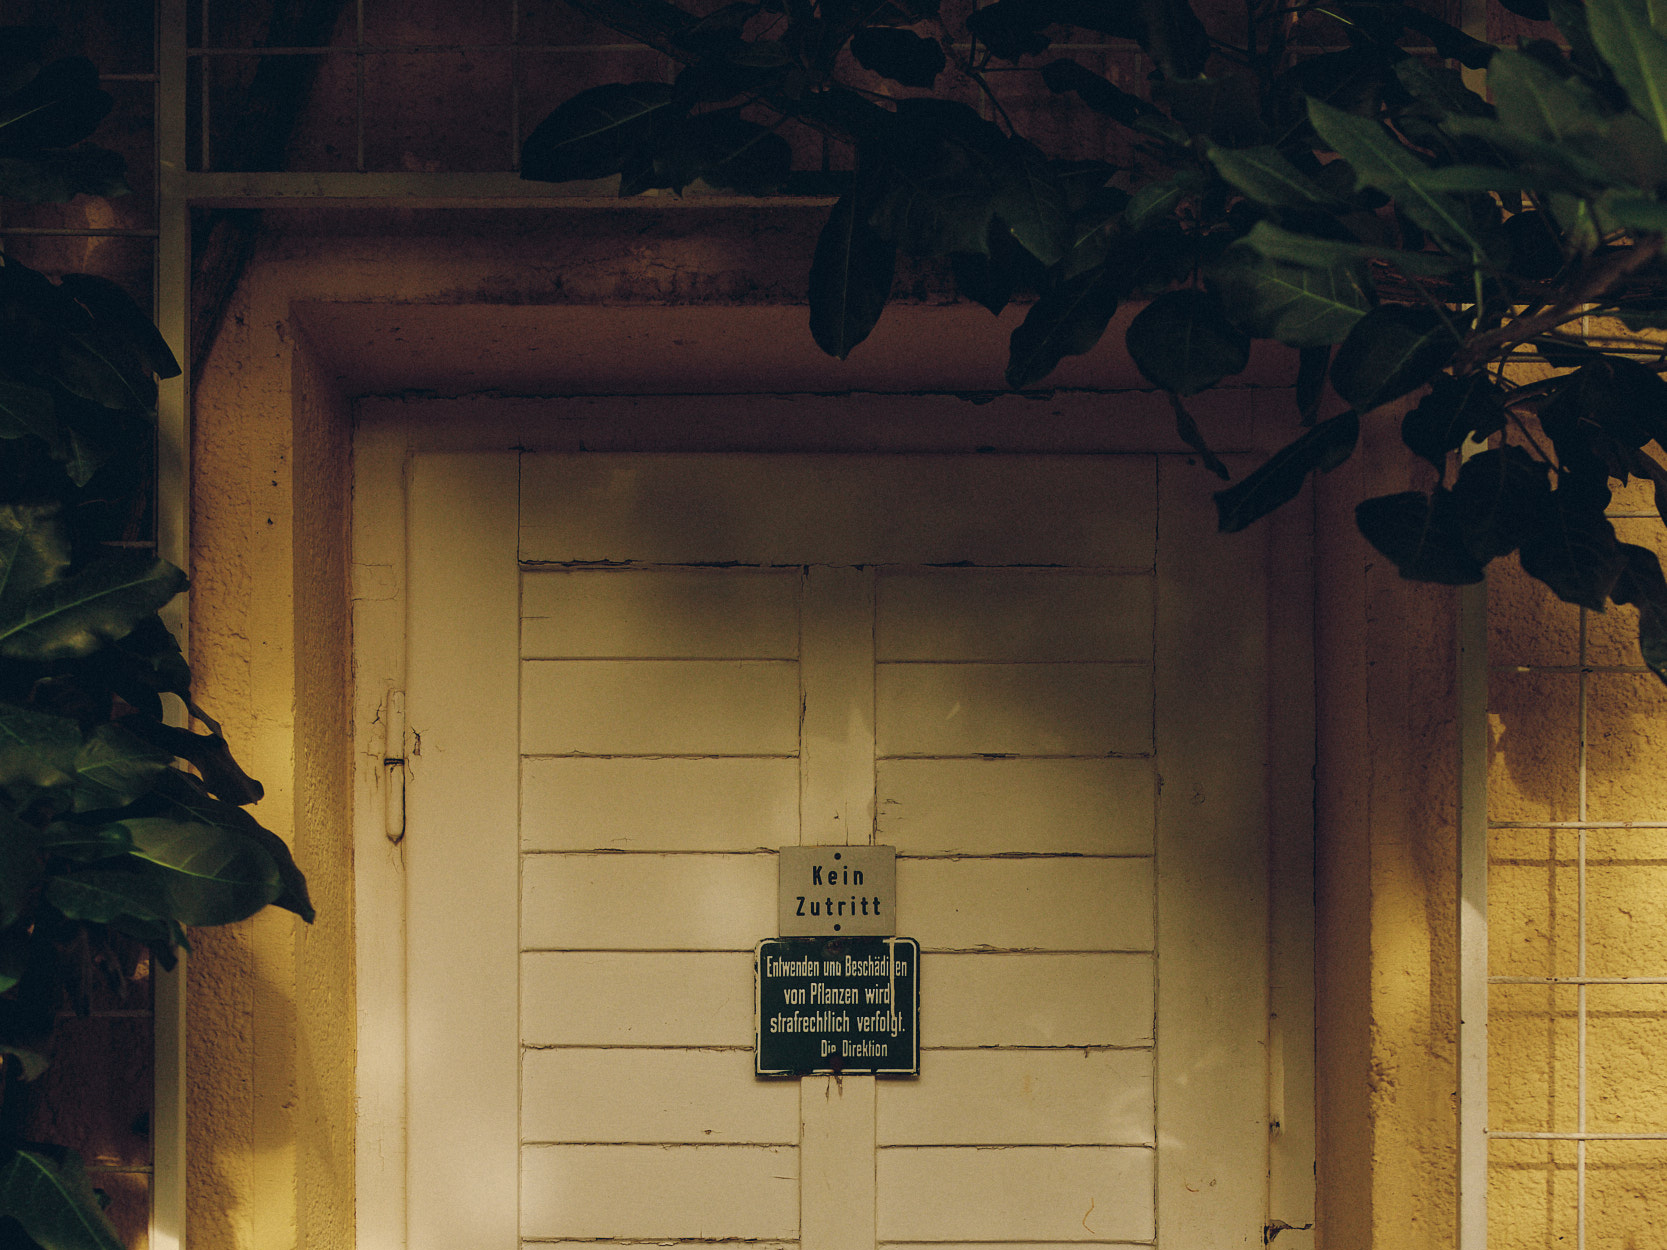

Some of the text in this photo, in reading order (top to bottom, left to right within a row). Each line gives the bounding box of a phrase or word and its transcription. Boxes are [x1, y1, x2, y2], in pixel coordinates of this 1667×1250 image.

[812, 865, 864, 886] Kein
[796, 896, 881, 917] Zutritt
[766, 955, 820, 978] Entwenden
[845, 955, 908, 978] Beschädien
[784, 982, 890, 1005] von Pflanzen wird
[770, 1011, 906, 1038] strafrechtlich verfolgt.
[820, 1039, 888, 1058] Die Direktion
